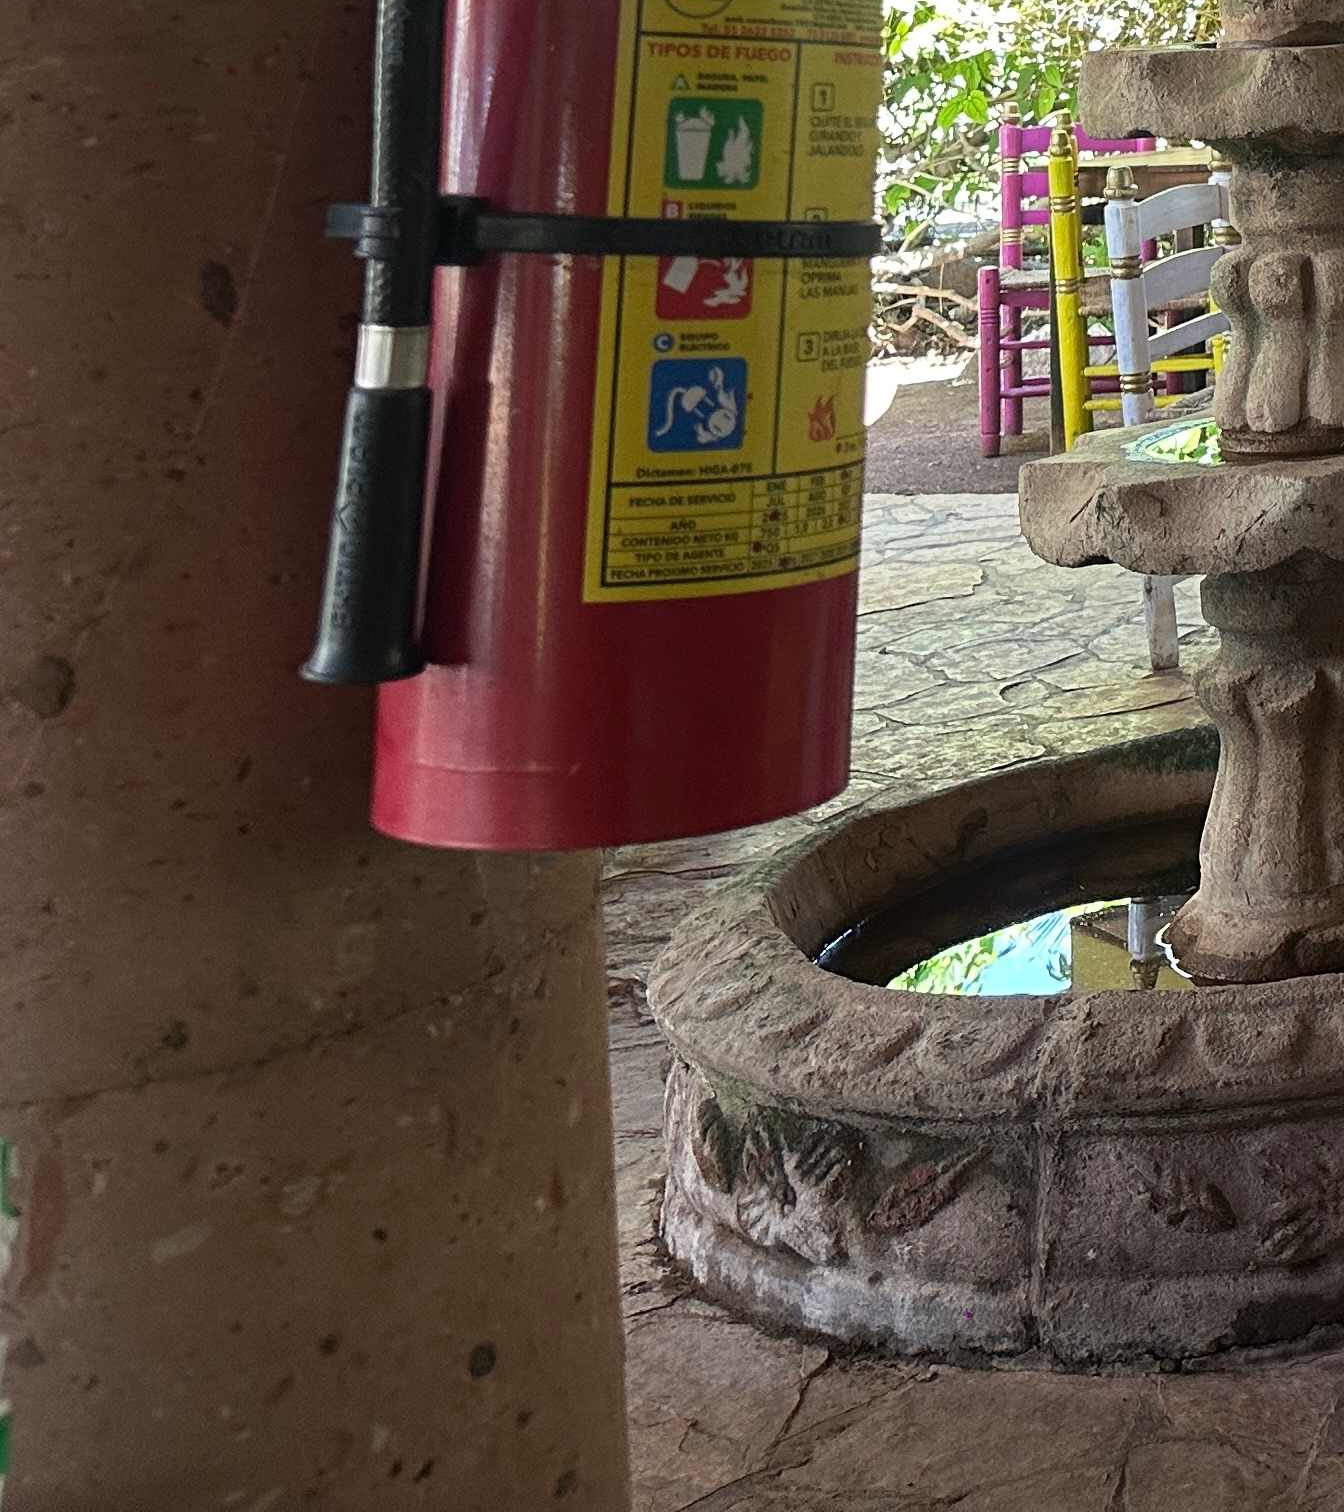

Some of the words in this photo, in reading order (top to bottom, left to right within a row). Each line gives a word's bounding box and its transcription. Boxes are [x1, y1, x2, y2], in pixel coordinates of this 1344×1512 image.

[648, 42, 702, 57] TIPOS
[707, 45, 730, 60] DE
[735, 46, 792, 62] FUEGO
[665, 203, 679, 219] B
[657, 334, 670, 350] C
